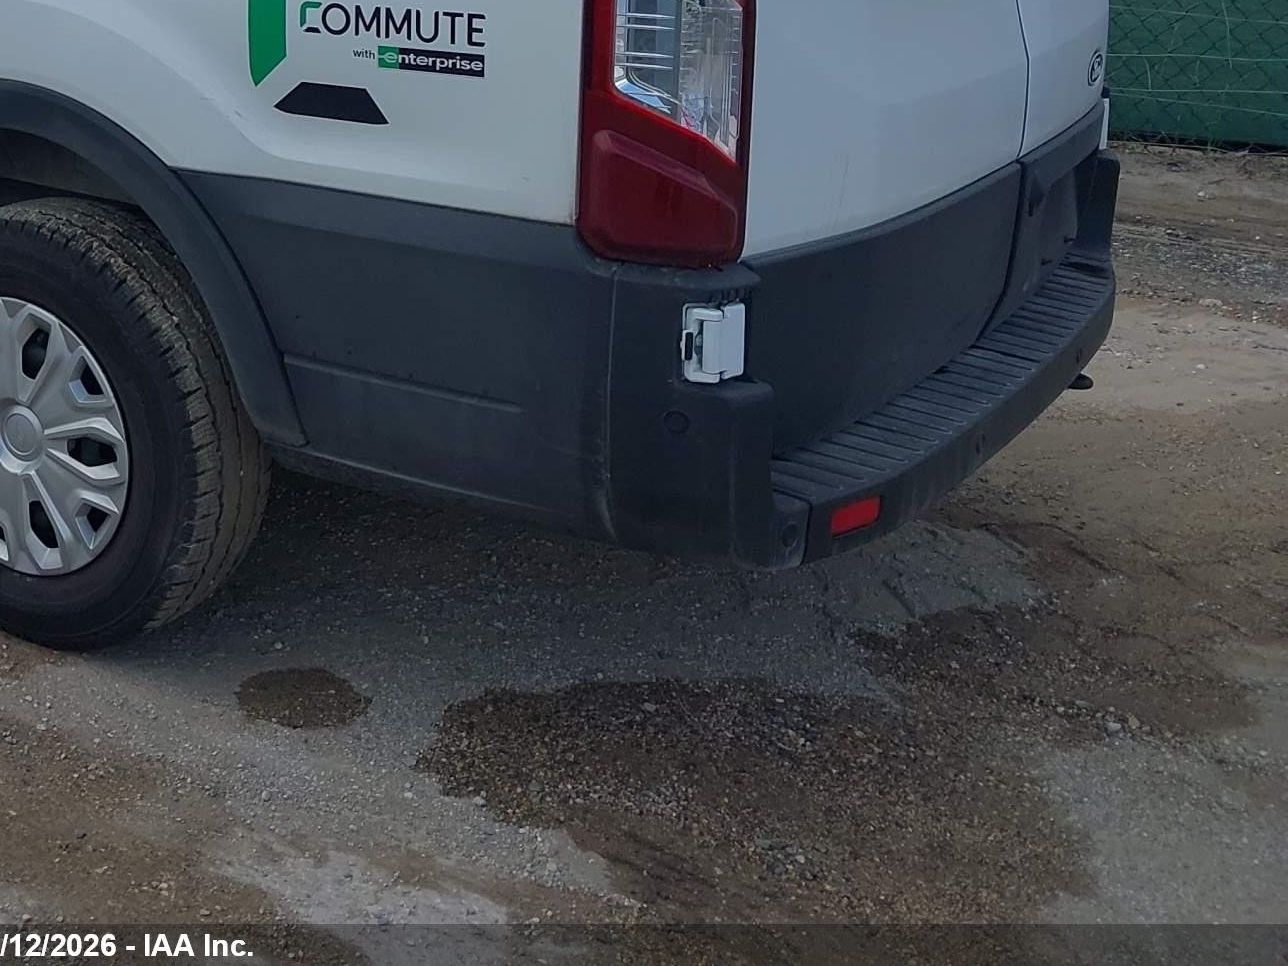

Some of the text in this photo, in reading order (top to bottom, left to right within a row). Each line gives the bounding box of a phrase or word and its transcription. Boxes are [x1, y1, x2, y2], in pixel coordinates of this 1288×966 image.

[299, 0, 487, 47] COMMUTE
[353, 48, 483, 71] with enterprise
